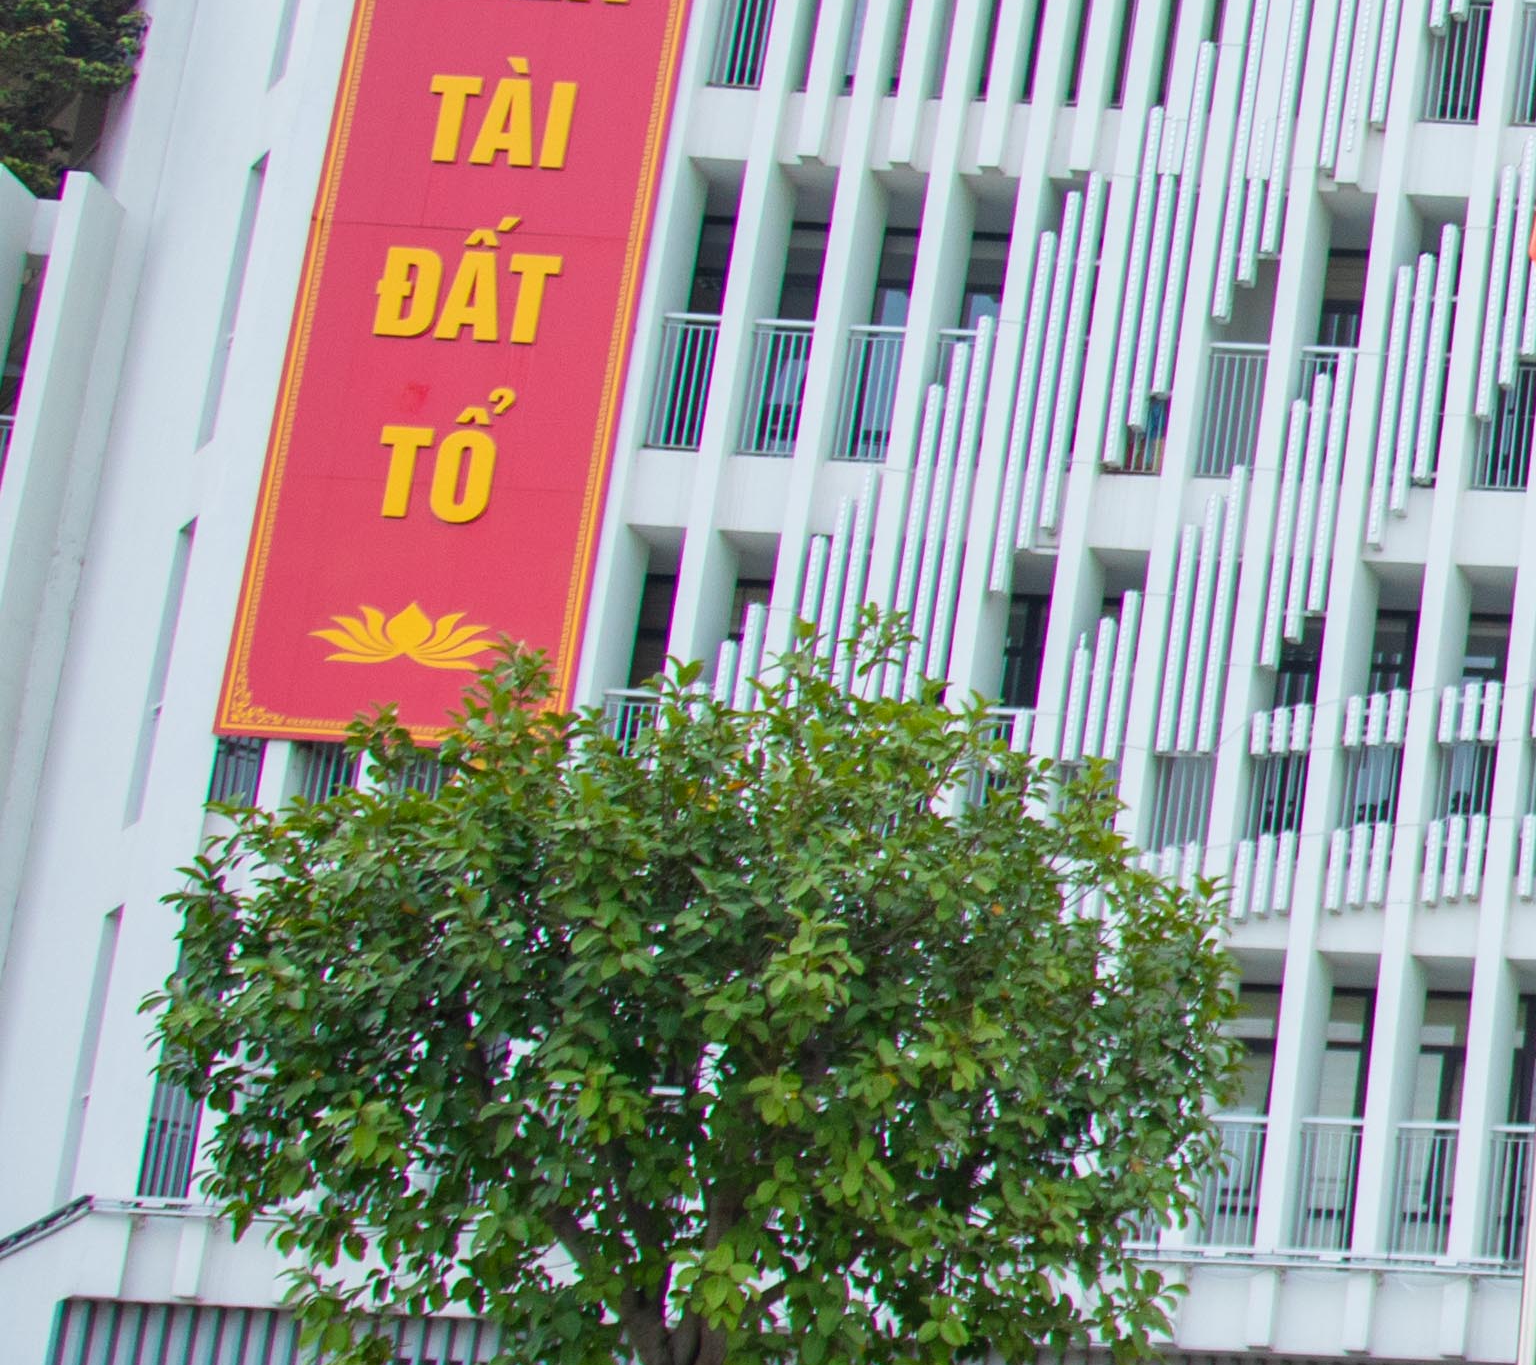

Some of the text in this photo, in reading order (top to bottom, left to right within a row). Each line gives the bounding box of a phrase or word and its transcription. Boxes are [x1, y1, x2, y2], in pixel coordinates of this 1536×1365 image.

[429, 56, 579, 171] TÀI
[372, 216, 564, 345] ĐẤT
[379, 387, 518, 525] TỔ
